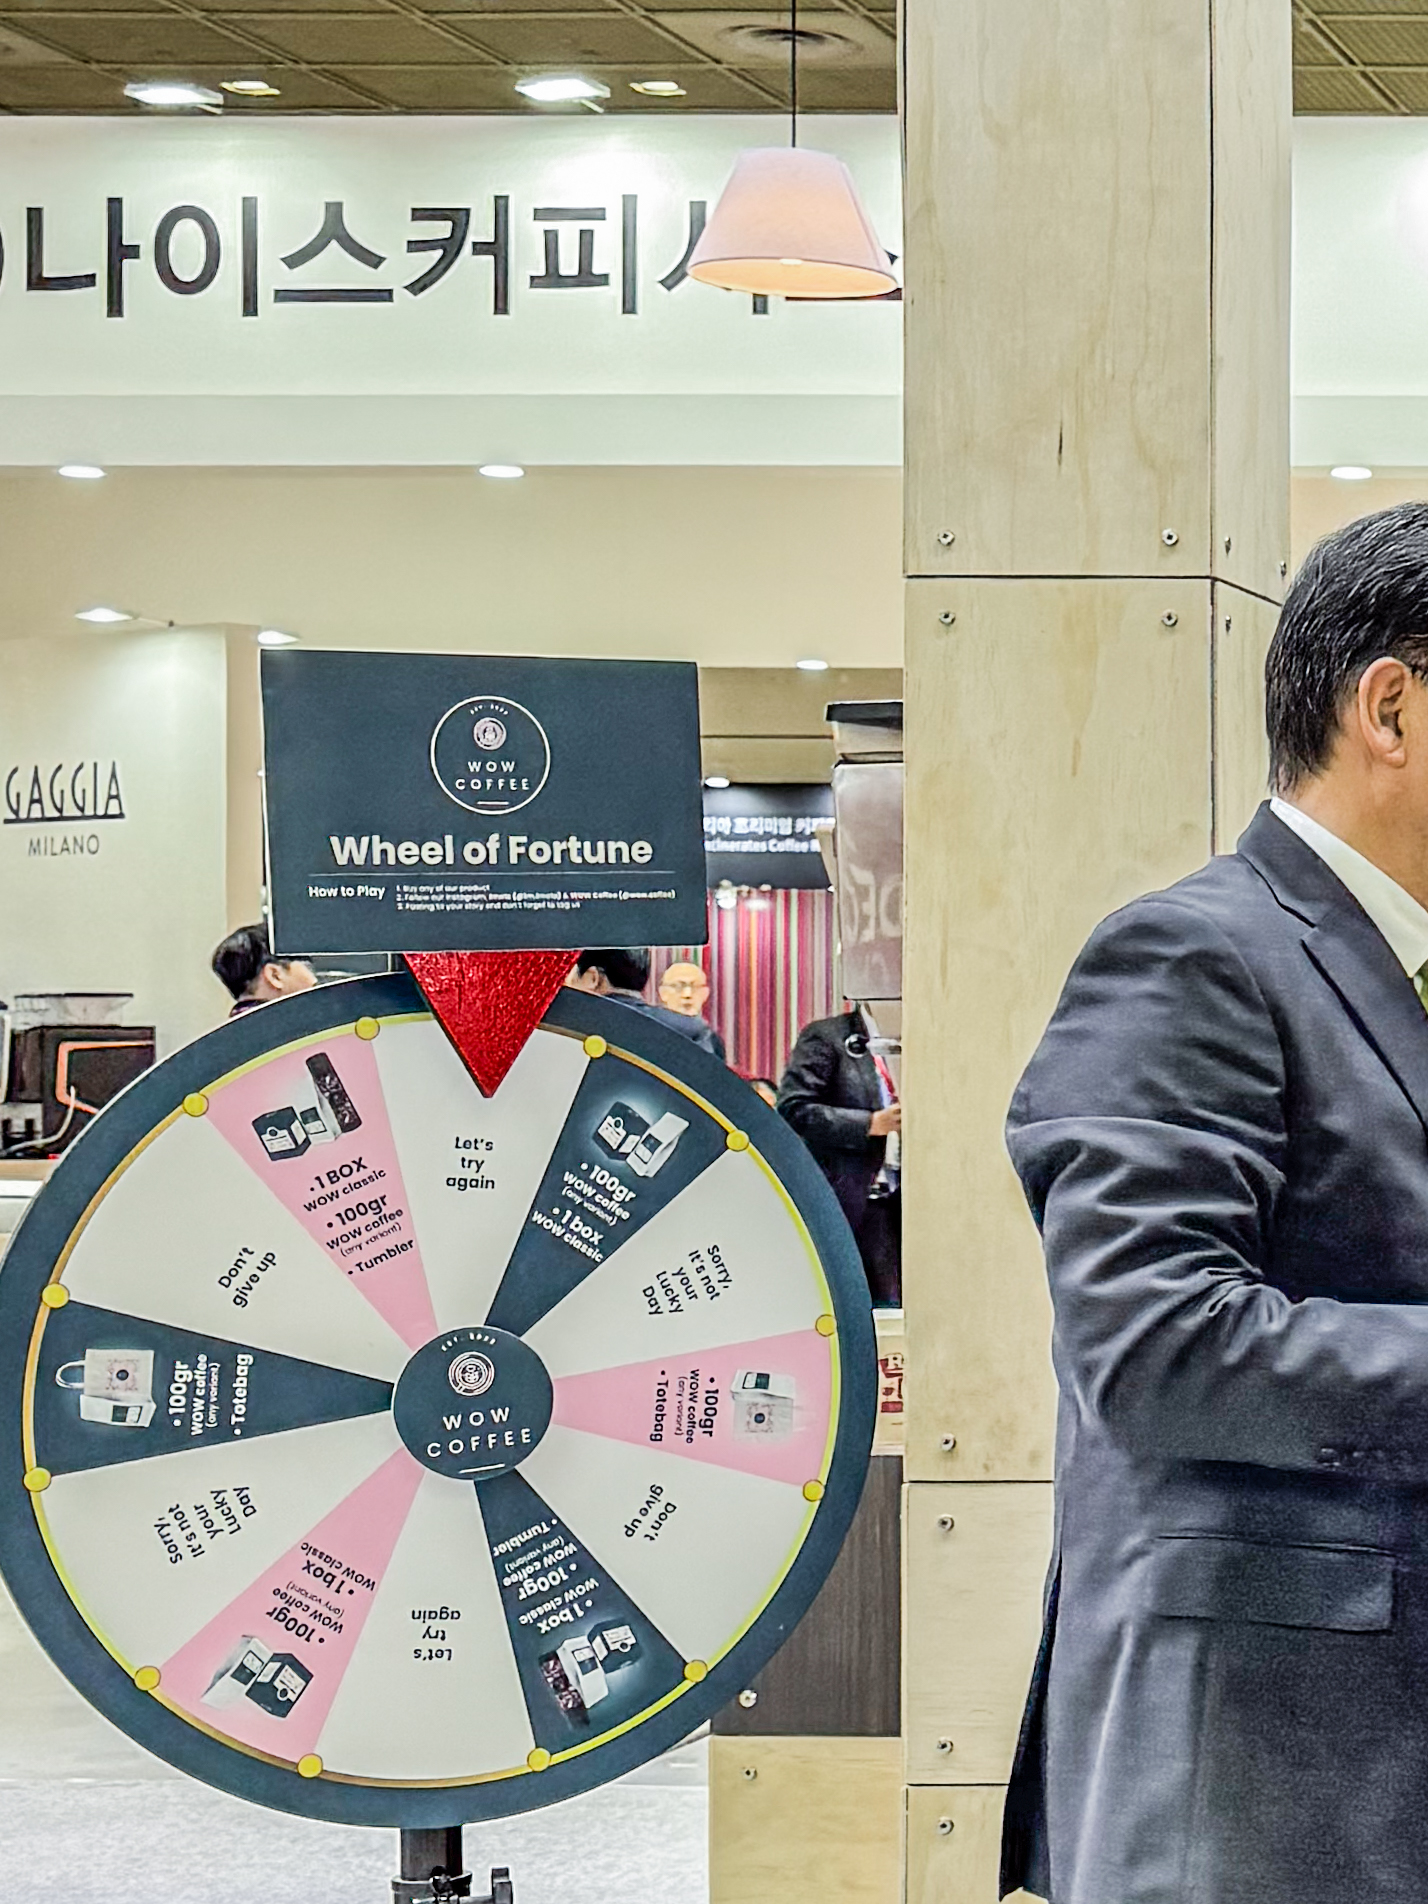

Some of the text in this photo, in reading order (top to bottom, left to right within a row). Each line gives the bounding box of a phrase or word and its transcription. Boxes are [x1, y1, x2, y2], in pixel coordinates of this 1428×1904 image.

[25, 193, 904, 319] 나이스커피
[467, 760, 516, 774] WOW
[4, 760, 125, 820] GAGGIA
[454, 777, 531, 792] COFFEE
[27, 835, 101, 857] MILANO
[329, 832, 654, 866] Wheel of Fortune
[308, 884, 340, 898] How
[341, 885, 355, 898] to
[357, 884, 386, 901] Play
[454, 1136, 494, 1151] Let's
[314, 1156, 368, 1189] 1 BOX
[460, 1156, 485, 1173] try
[342, 1168, 387, 1195] classic
[445, 1174, 495, 1191] again
[589, 1163, 637, 1203] 100gr
[335, 1194, 388, 1226] 100gr
[364, 1208, 404, 1233] coffee
[595, 1192, 631, 1221] coffee
[569, 1215, 604, 1245] box
[355, 1239, 415, 1273] Tumbler
[563, 1232, 604, 1263] classic
[217, 1246, 257, 1289] Don't
[232, 1250, 277, 1309] give up
[707, 1244, 733, 1290] Sorry,
[655, 1270, 684, 1314] Lucky
[671, 1267, 699, 1301] your
[700, 1275, 721, 1301] not
[642, 1285, 664, 1316] Day
[169, 1360, 194, 1416] 100gr
[194, 1353, 209, 1395] coffee
[231, 1353, 254, 1425] Totebag
[442, 1406, 510, 1431] WOW
[649, 1379, 669, 1443] Totebag
[685, 1405, 698, 1444] coffee
[698, 1388, 720, 1438] 100gr
[427, 1428, 531, 1458] COFFEE
[169, 1503, 190, 1531] not
[210, 1489, 242, 1535] Lucky
[232, 1486, 257, 1518] Day
[624, 1483, 664, 1539] give up
[194, 1503, 225, 1540] your
[643, 1501, 678, 1542] Don't
[154, 1517, 183, 1565] Sorry,
[493, 1521, 551, 1557] Tumbler
[300, 1542, 343, 1570] classic
[301, 1559, 338, 1588] box
[502, 1561, 541, 1587] coffee
[518, 1566, 569, 1600] 100gr
[272, 1587, 310, 1613] coffee
[411, 1606, 462, 1624] again
[518, 1596, 563, 1625] classic
[266, 1606, 316, 1643] 100gr
[422, 1625, 447, 1641] try
[537, 1607, 575, 1634] box
[413, 1648, 453, 1661] Let's
